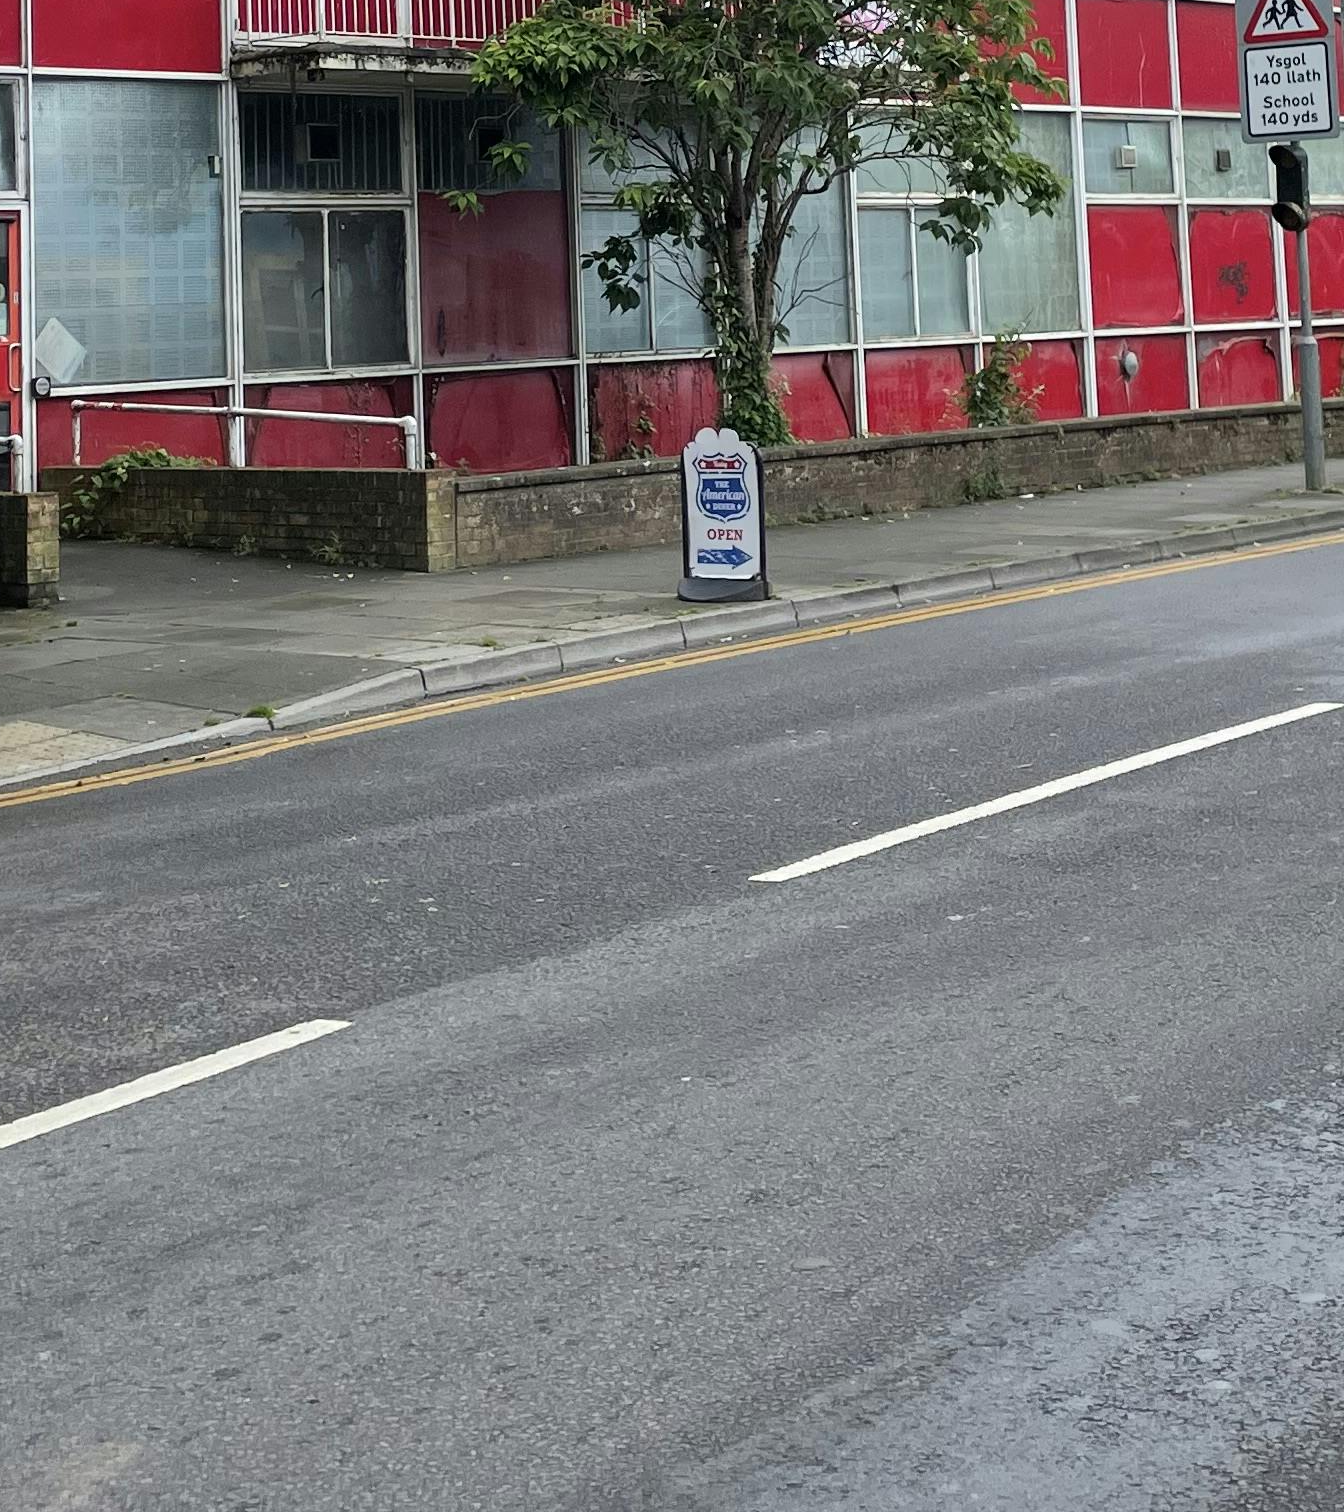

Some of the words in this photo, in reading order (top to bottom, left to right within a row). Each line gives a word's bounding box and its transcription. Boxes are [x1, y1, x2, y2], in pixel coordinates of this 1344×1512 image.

[1266, 52, 1307, 70] Ysgol
[1253, 72, 1281, 86] 140
[1286, 69, 1321, 84] llath
[1263, 92, 1315, 109] School
[1261, 111, 1288, 126] 140
[1292, 109, 1319, 127] yds
[714, 480, 730, 488] THE
[701, 487, 745, 501] American
[707, 528, 743, 541] OPEN
